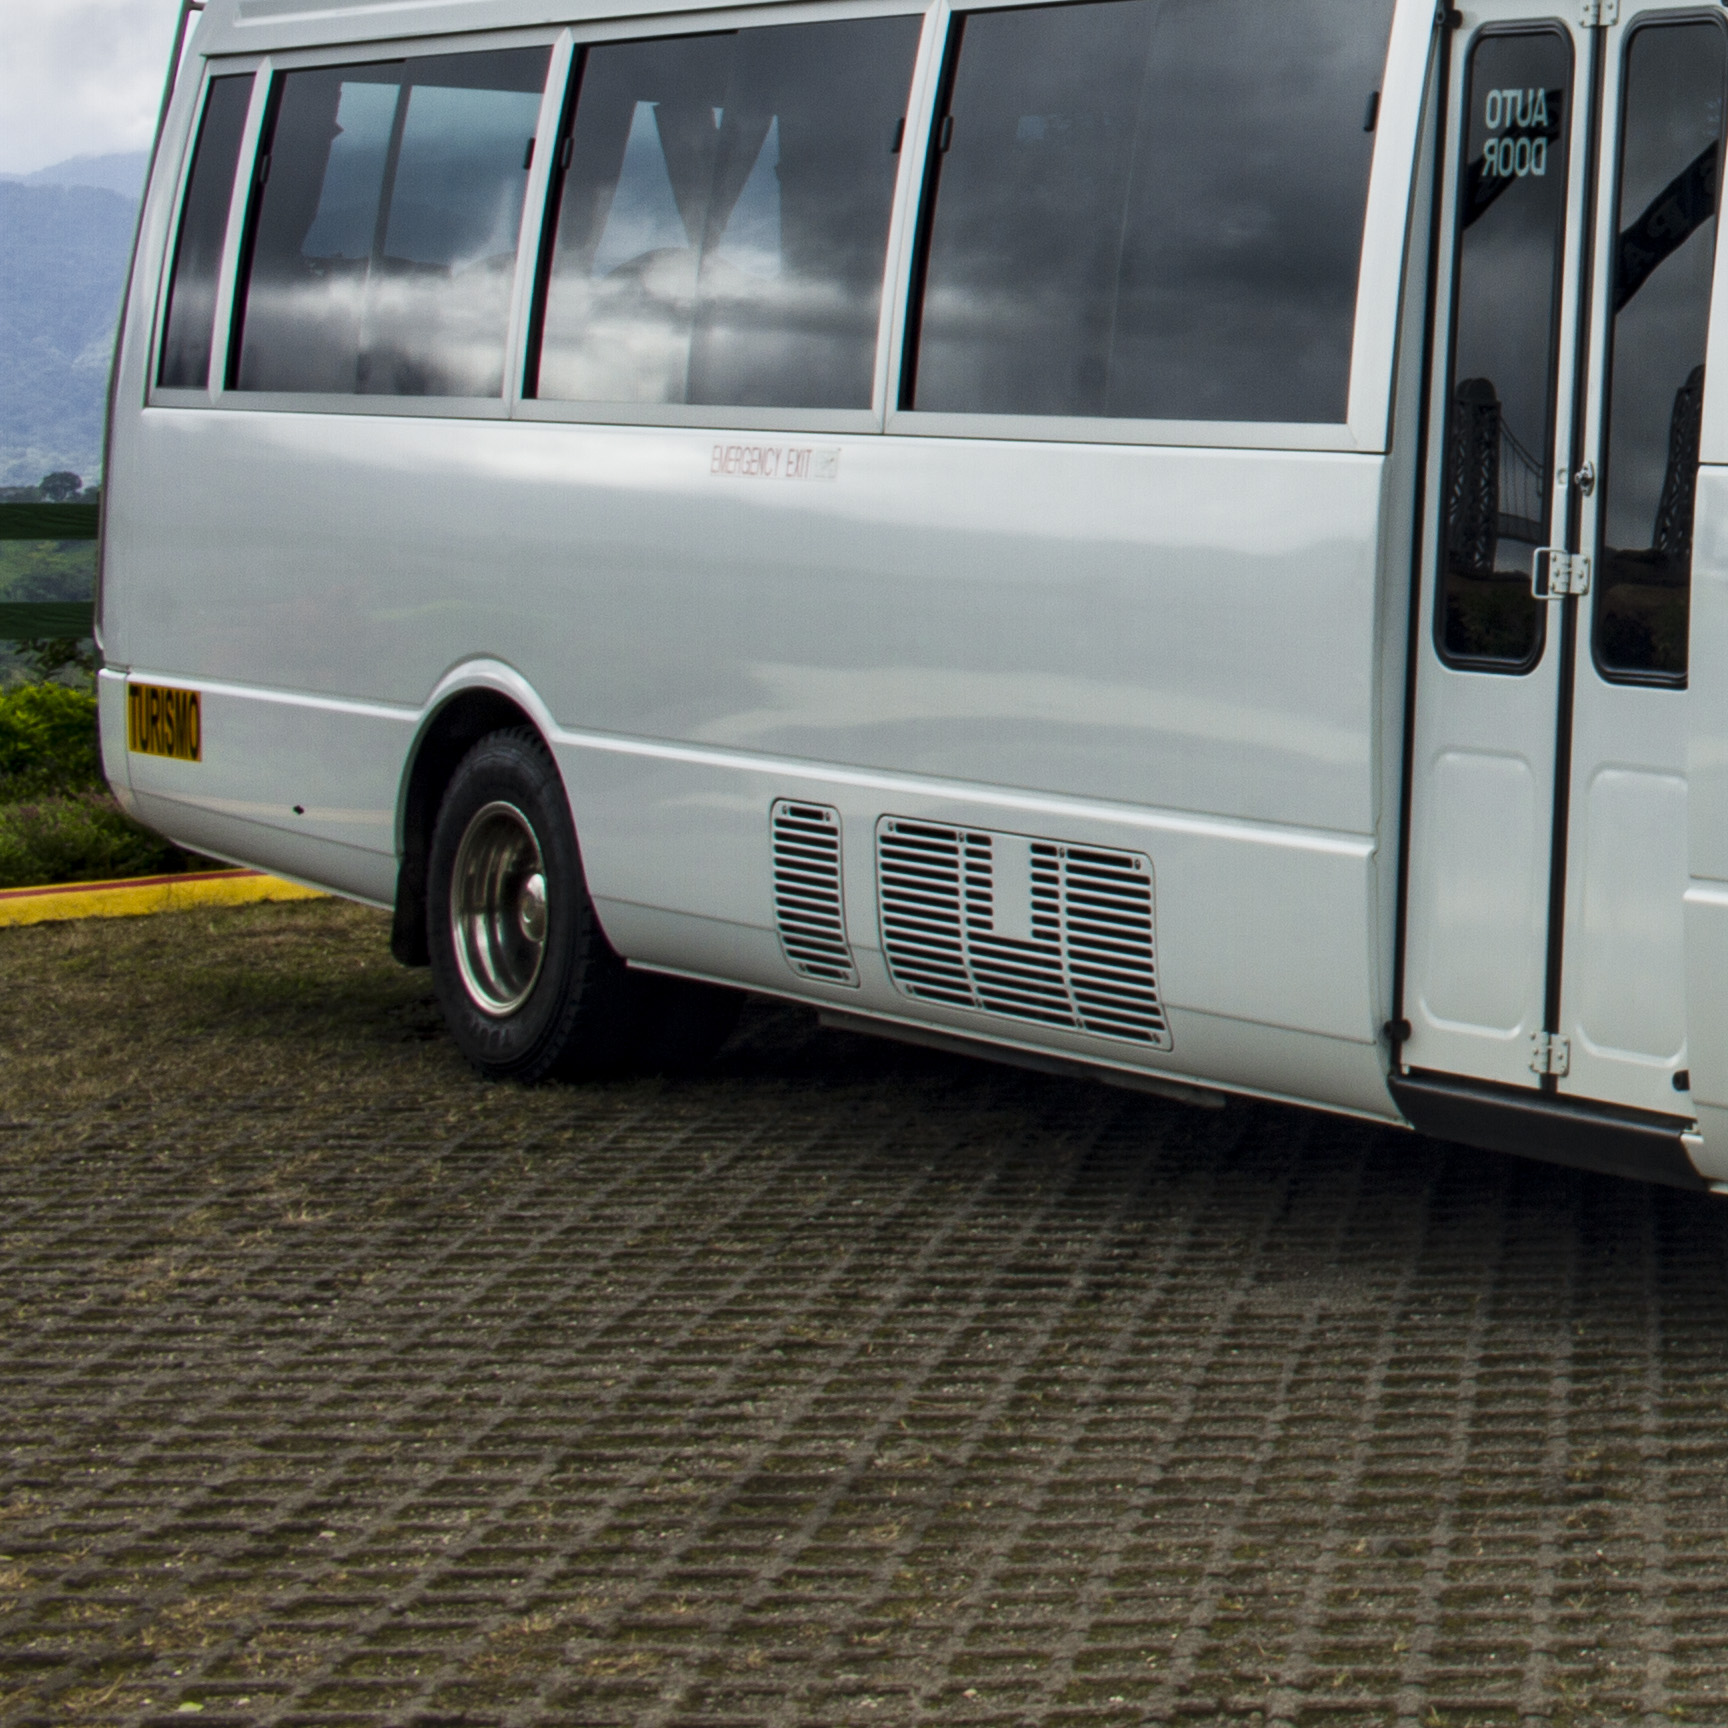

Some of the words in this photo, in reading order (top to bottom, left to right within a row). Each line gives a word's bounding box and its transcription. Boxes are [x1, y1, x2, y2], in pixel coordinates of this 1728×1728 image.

[710, 445, 782, 476] EMERGENCY
[786, 448, 812, 478] EXIT
[129, 684, 199, 760] TURISMO
